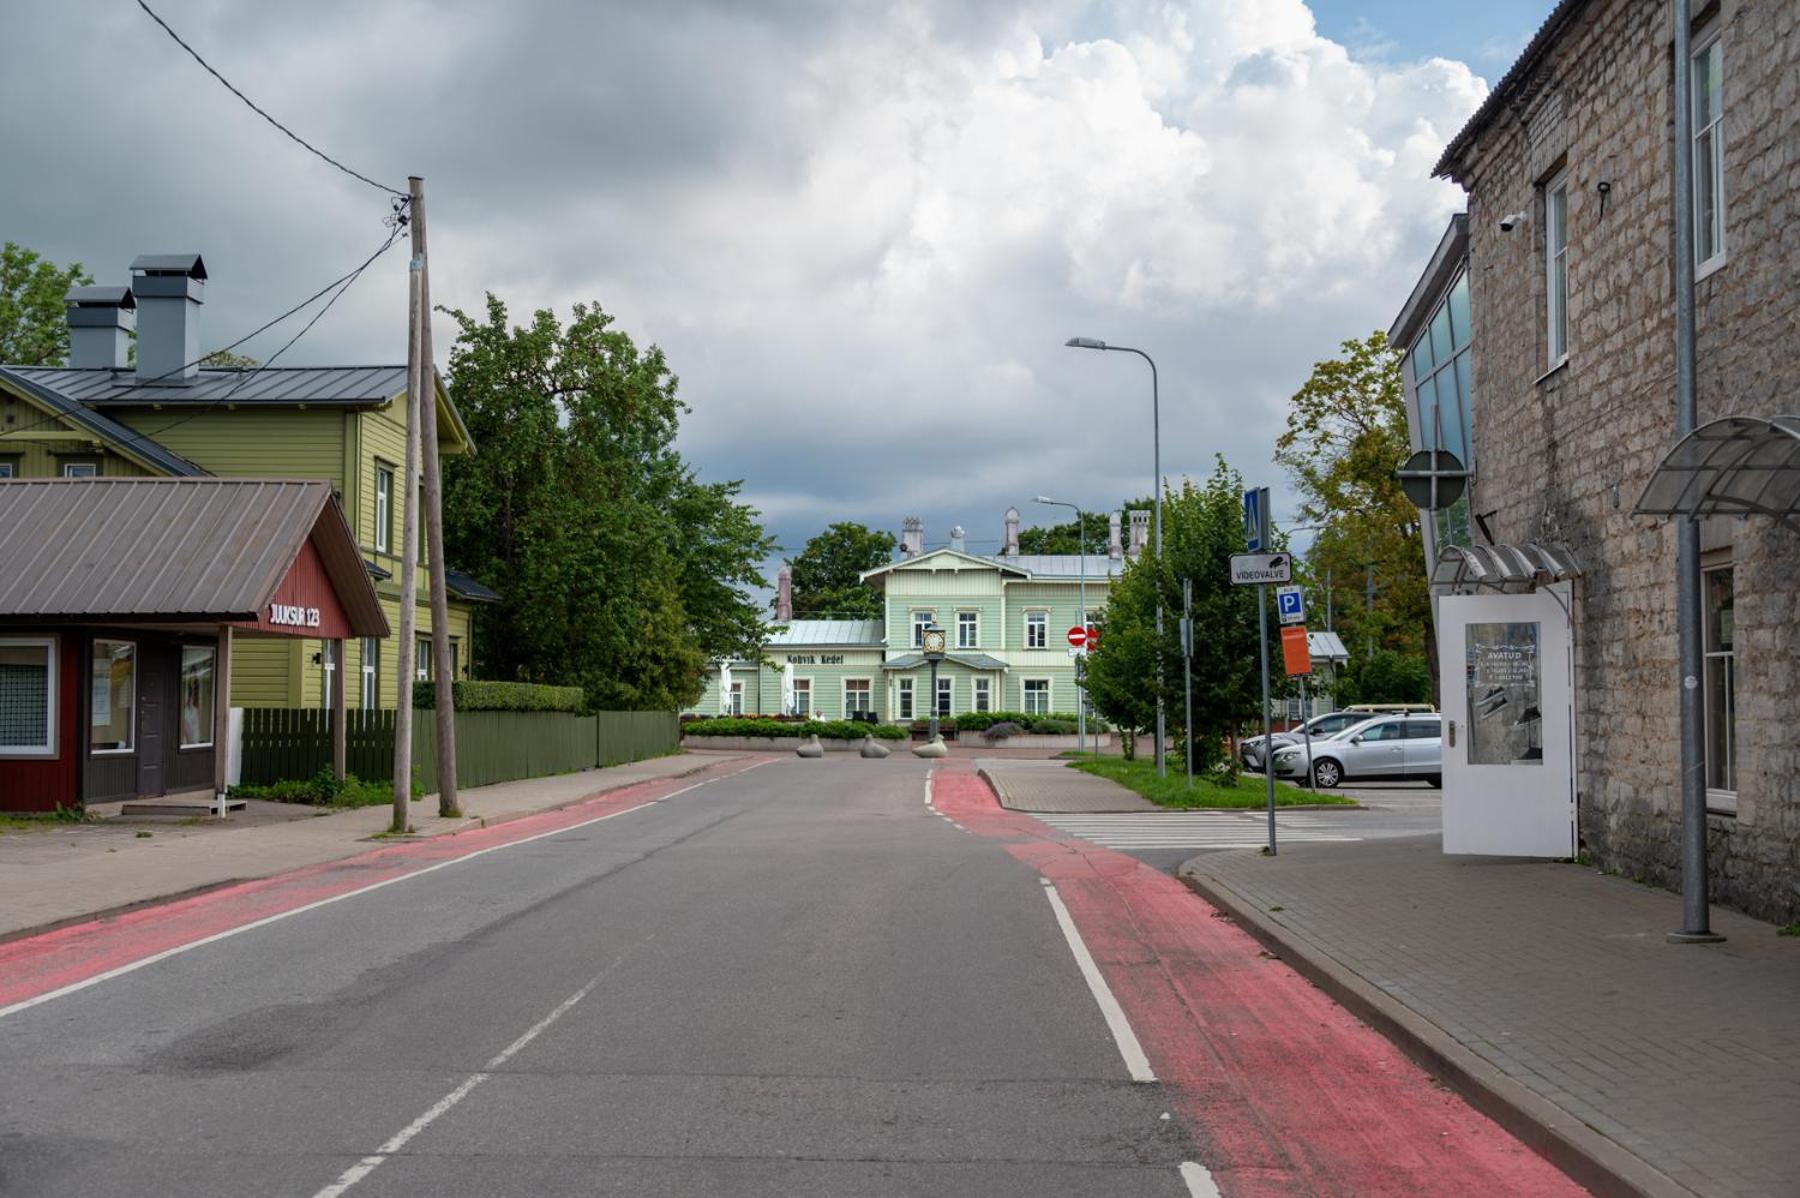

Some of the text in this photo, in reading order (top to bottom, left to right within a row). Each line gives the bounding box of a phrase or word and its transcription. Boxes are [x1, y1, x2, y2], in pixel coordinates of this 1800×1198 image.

[1236, 569, 1284, 580] VIDEOVALVE
[1283, 595, 1295, 612] P
[269, 603, 320, 627] JUUKSUR 123
[787, 655, 816, 665] Kohvik
[1487, 652, 1522, 660] AVATUD
